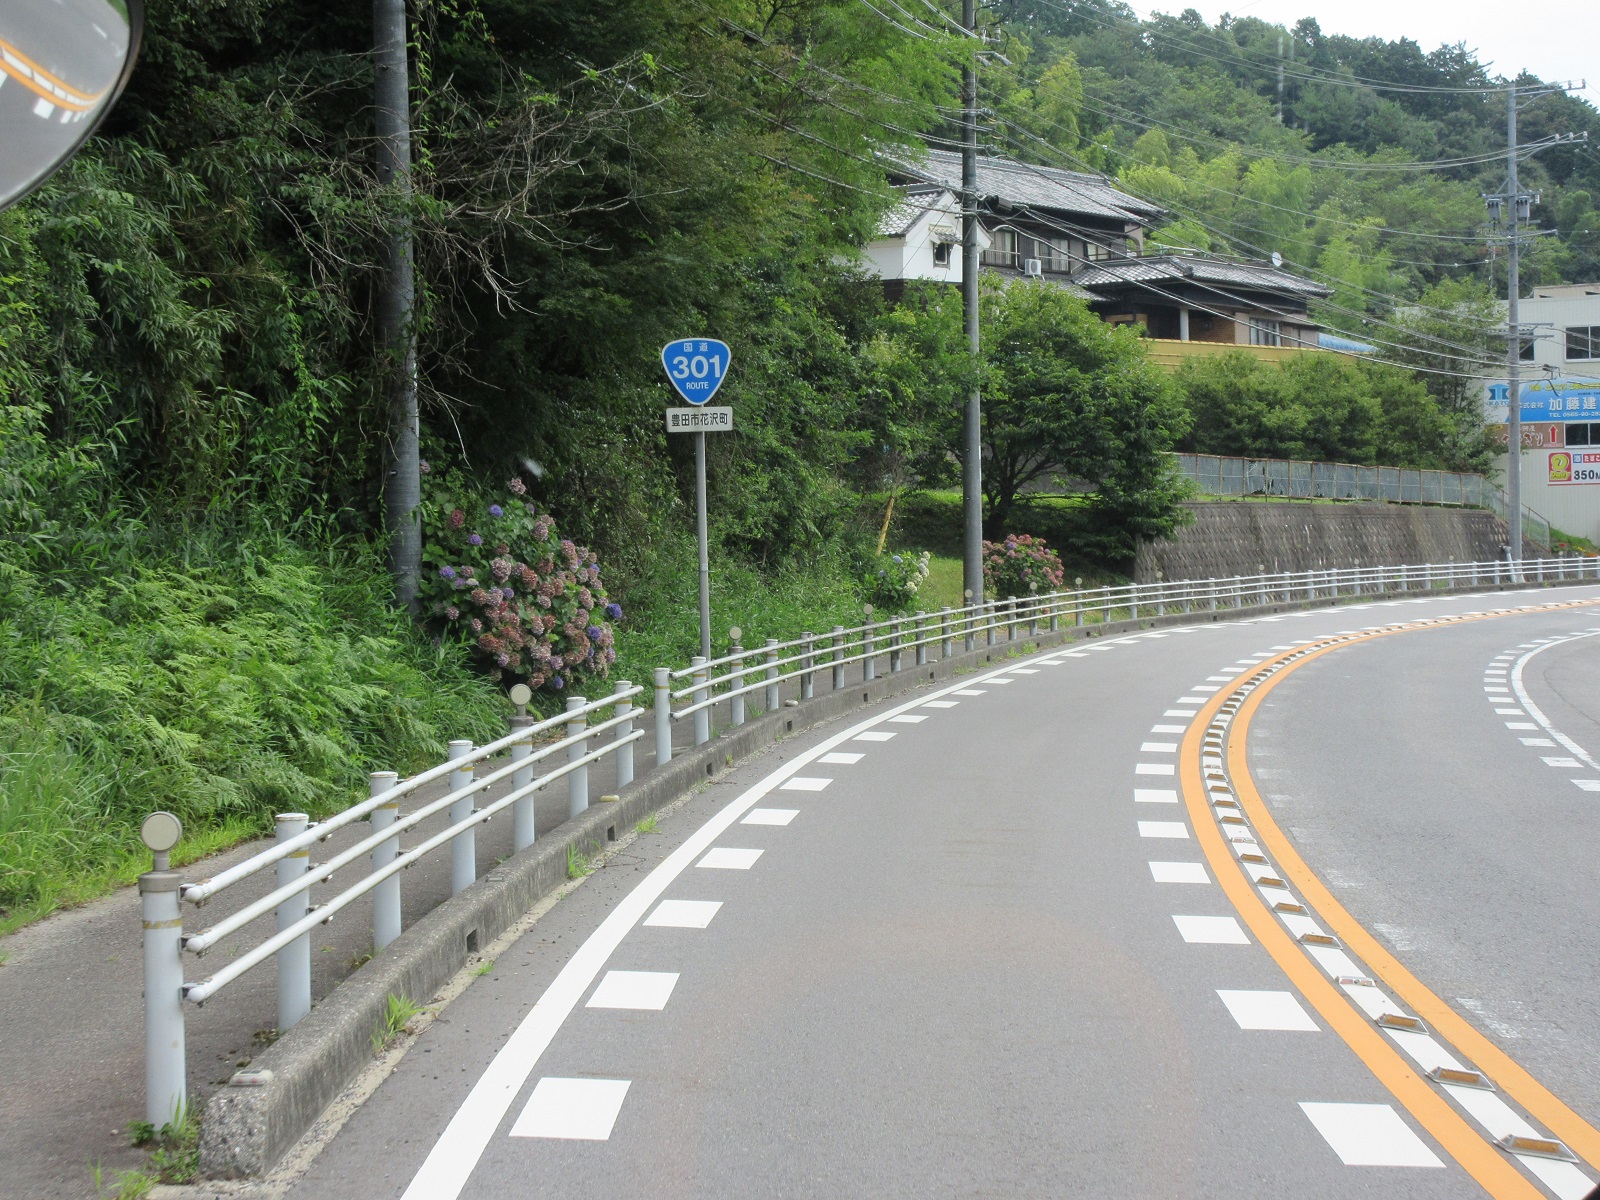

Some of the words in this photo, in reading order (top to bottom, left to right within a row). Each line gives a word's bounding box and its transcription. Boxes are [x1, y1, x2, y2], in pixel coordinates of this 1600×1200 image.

[683, 342, 708, 352] 国道
[672, 355, 721, 379] 301
[686, 381, 709, 390] ROUTE
[1548, 396, 1597, 411] 加藤建
[671, 412, 728, 427] 豊田市花沢町
